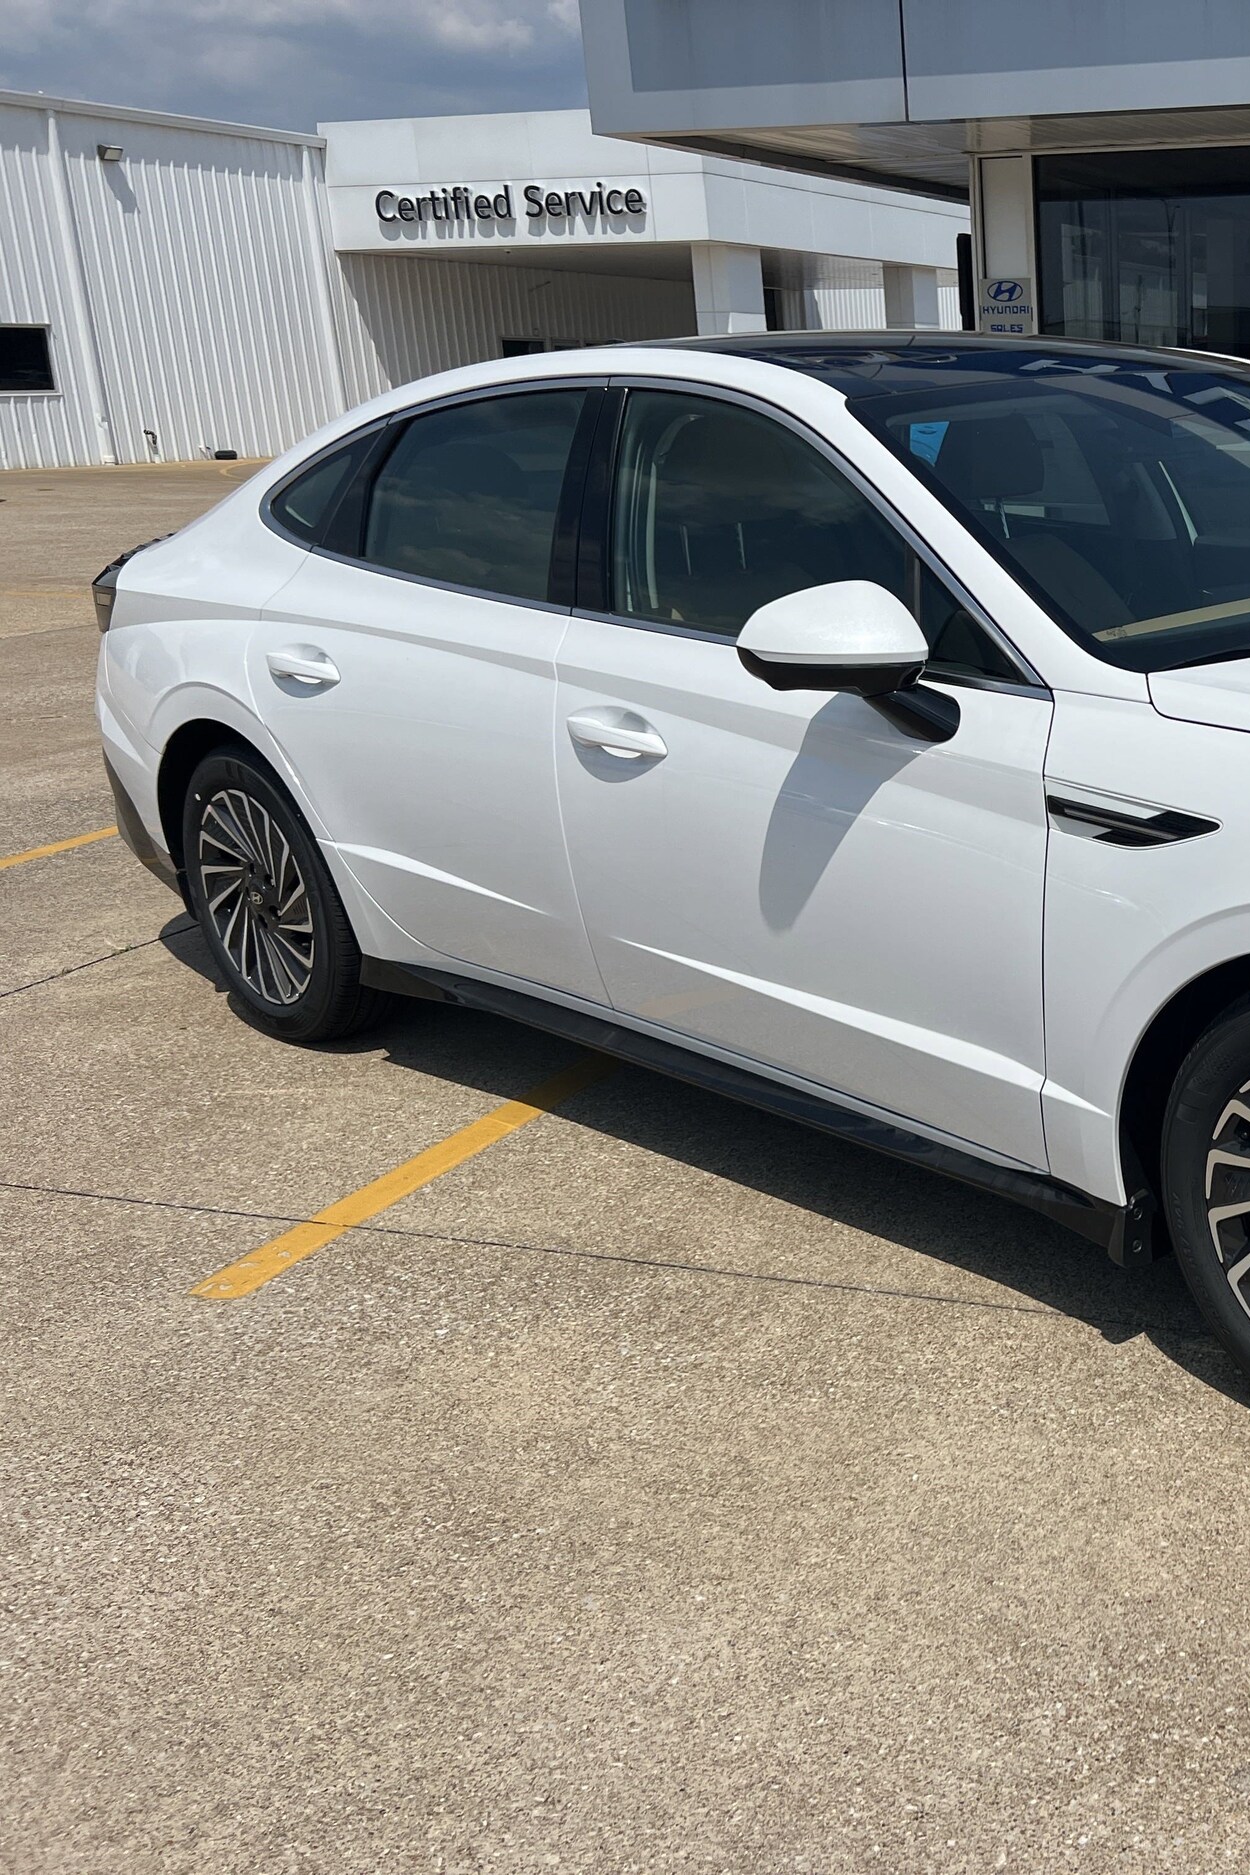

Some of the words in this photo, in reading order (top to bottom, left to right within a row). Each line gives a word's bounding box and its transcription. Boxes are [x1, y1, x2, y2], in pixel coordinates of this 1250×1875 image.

[375, 184, 512, 223] Certified
[523, 182, 646, 218] Service
[982, 305, 1030, 315] HYUNDAI
[990, 324, 1024, 334] SALES
